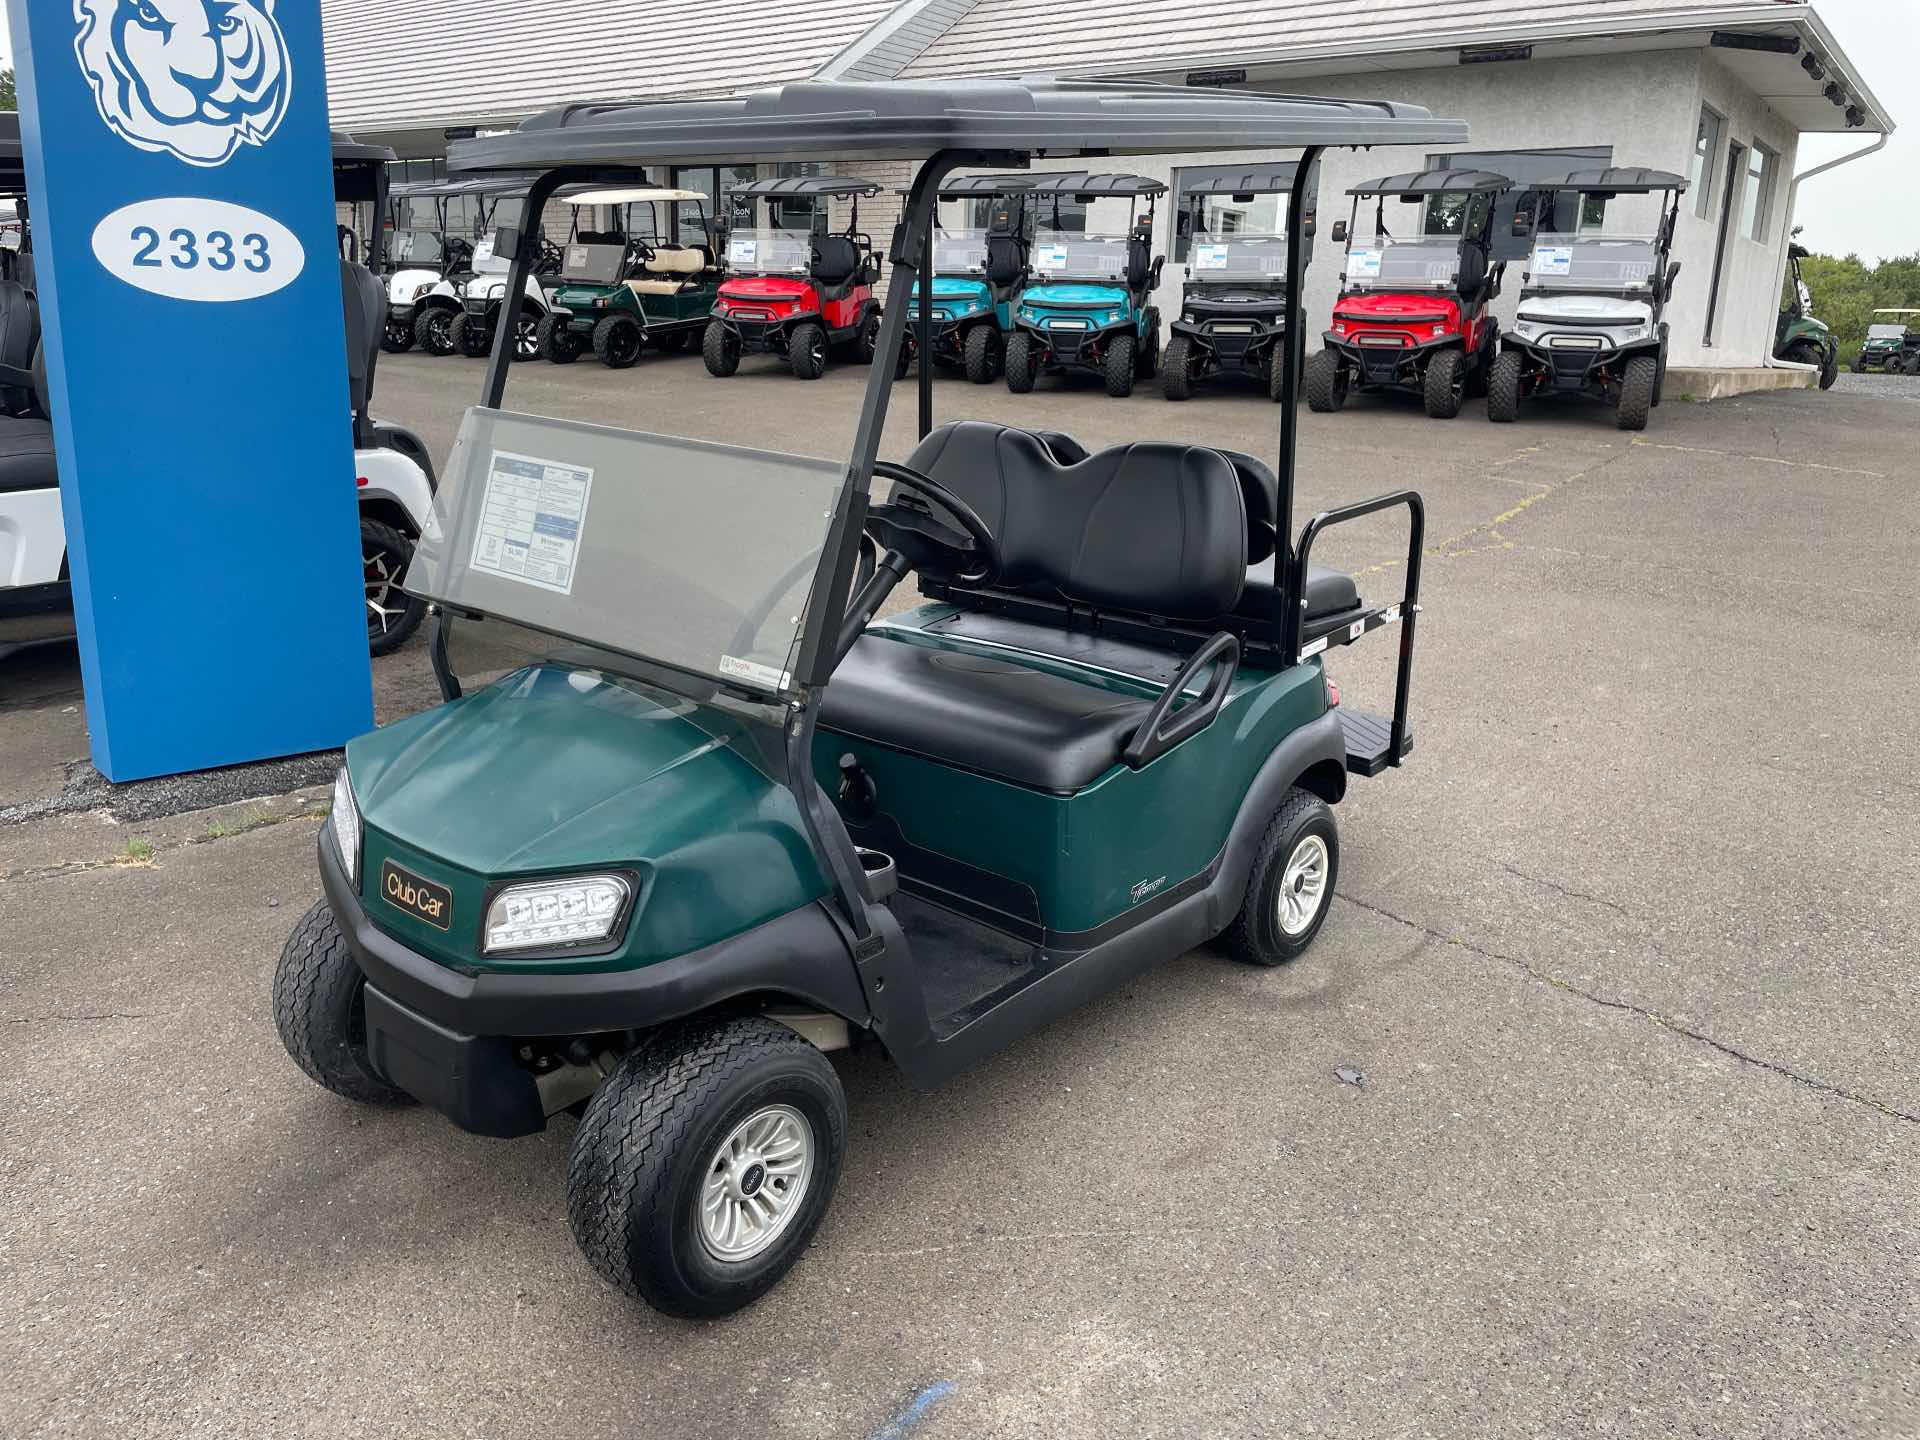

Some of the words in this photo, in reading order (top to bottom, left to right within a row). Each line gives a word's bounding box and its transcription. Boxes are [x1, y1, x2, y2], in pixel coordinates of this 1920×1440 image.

[130, 225, 272, 273] 2333
[387, 872, 416, 906] Club
[417, 887, 444, 917] Car
